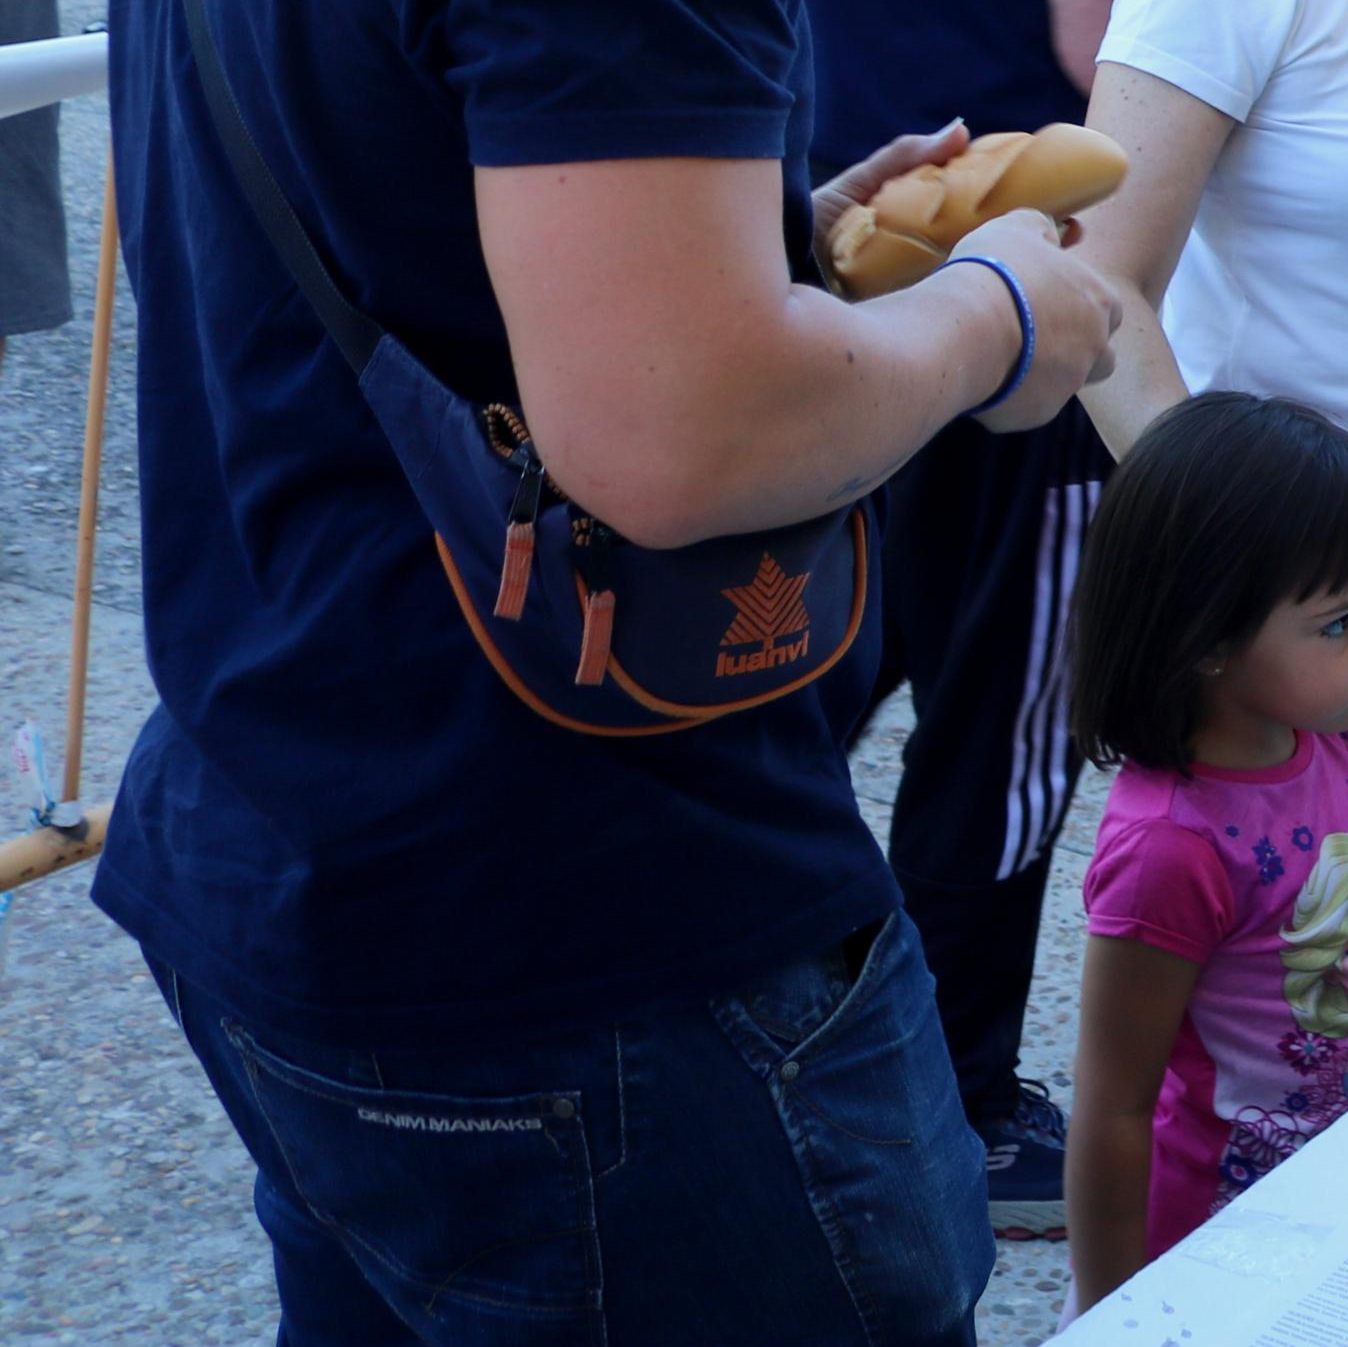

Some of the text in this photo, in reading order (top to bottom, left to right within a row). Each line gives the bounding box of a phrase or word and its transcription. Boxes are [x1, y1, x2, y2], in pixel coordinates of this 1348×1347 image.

[715, 630, 810, 677] luanvi
[358, 1107, 542, 1132] DENIM MANIAKS
